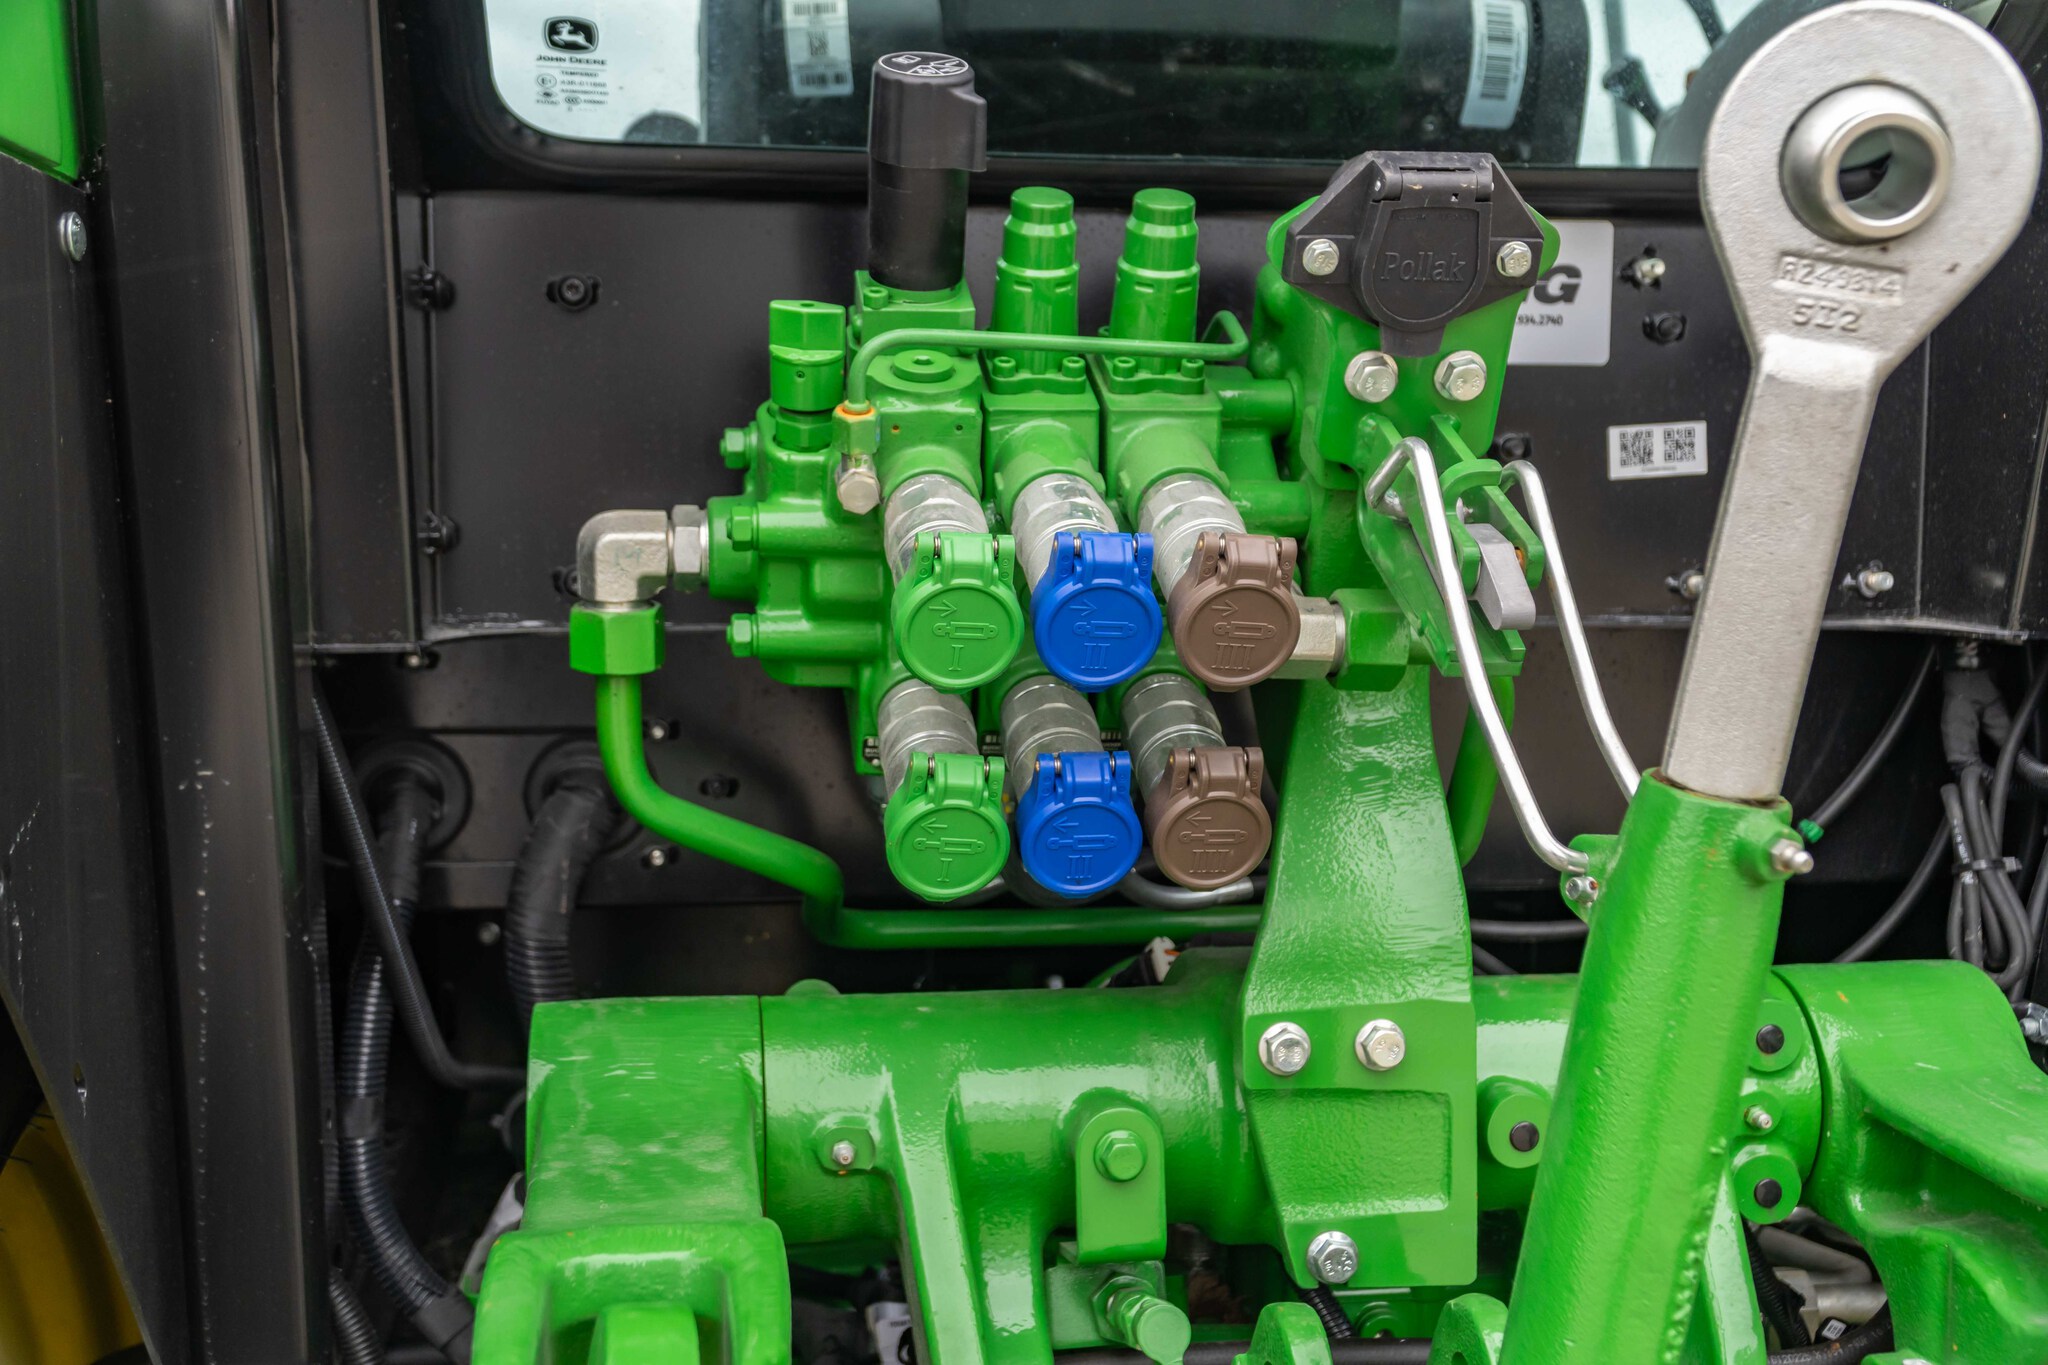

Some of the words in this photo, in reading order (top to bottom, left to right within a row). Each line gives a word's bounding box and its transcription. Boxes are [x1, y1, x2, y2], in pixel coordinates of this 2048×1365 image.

[536, 54, 566, 63] JOHN
[568, 56, 608, 66] DEERE
[1379, 251, 1467, 282] Pollak
[1081, 643, 1111, 669] II
[1211, 643, 1256, 670] III
[1188, 849, 1230, 873] III
